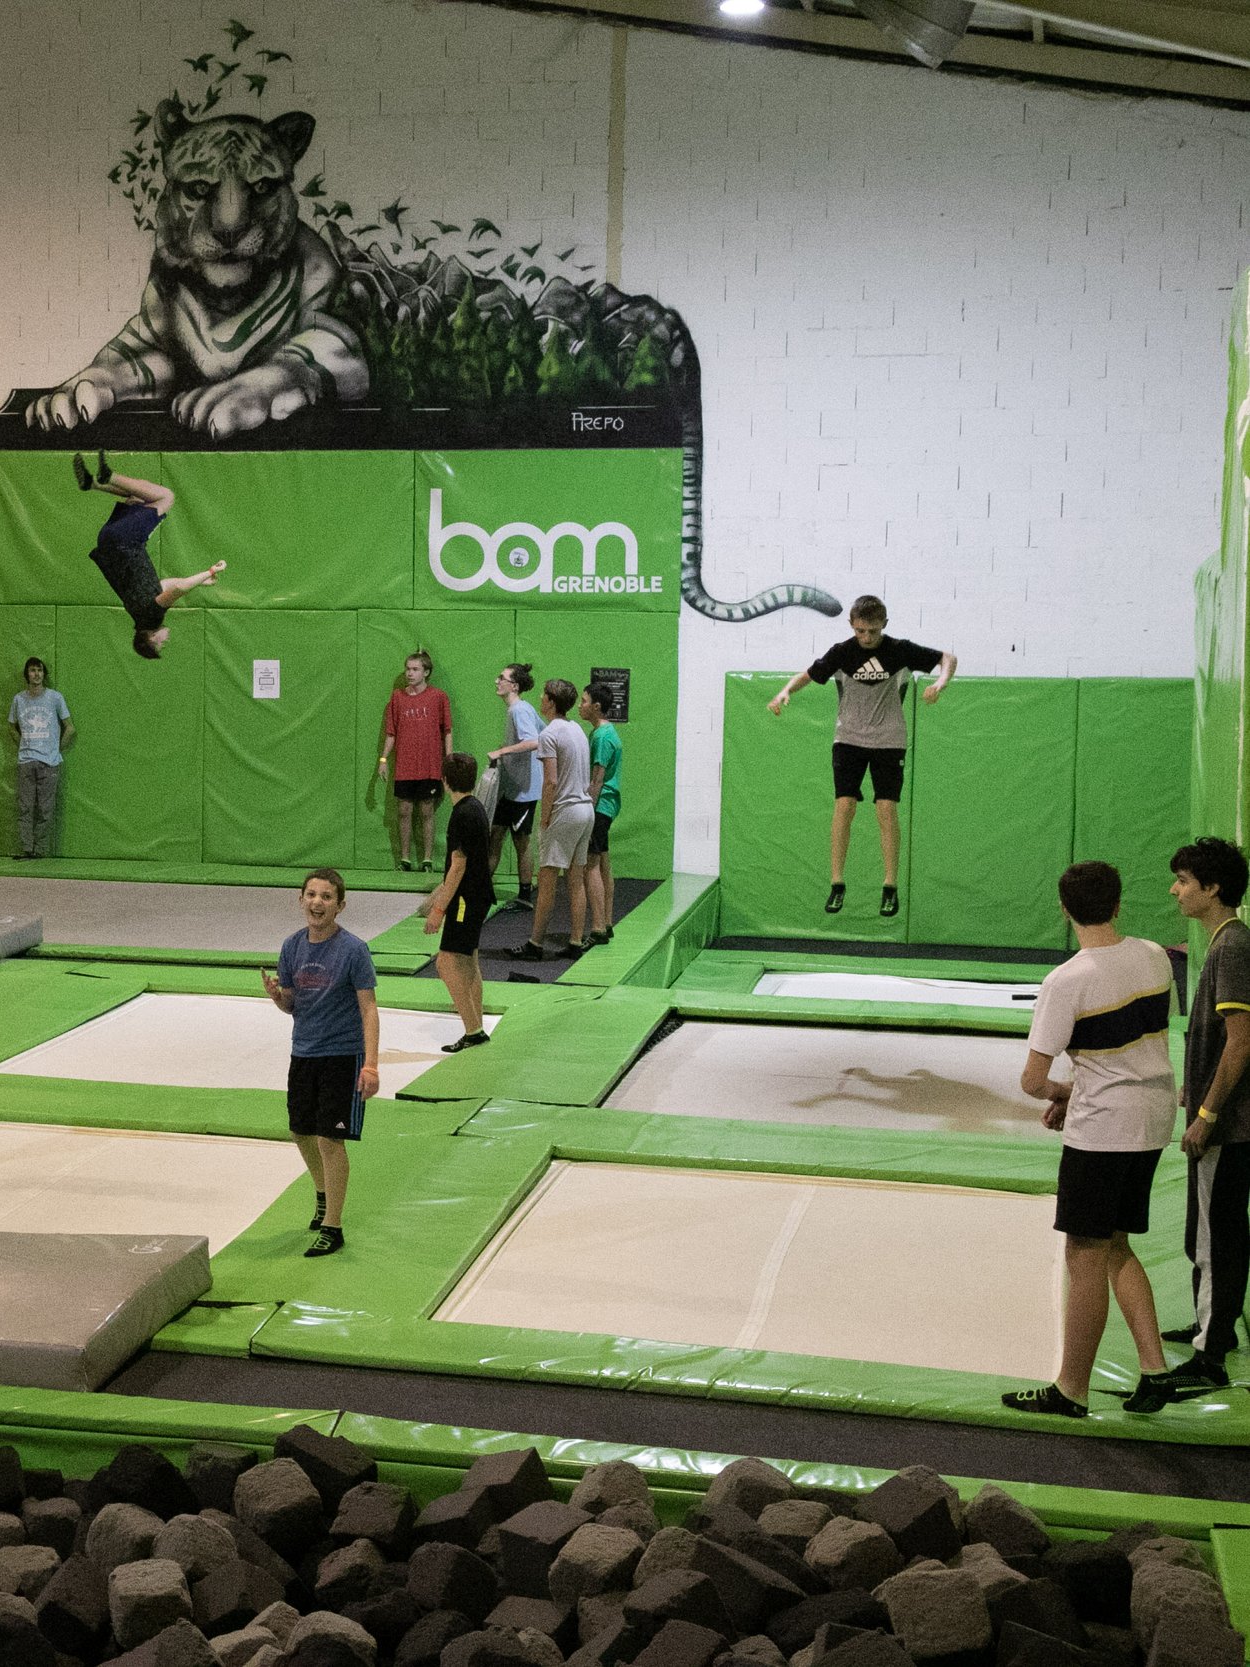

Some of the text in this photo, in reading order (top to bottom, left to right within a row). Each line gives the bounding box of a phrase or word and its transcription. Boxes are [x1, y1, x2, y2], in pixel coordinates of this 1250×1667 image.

[428, 488, 639, 593] bam
[553, 576, 663, 593] GRENOBLE
[853, 671, 890, 680] adidas
